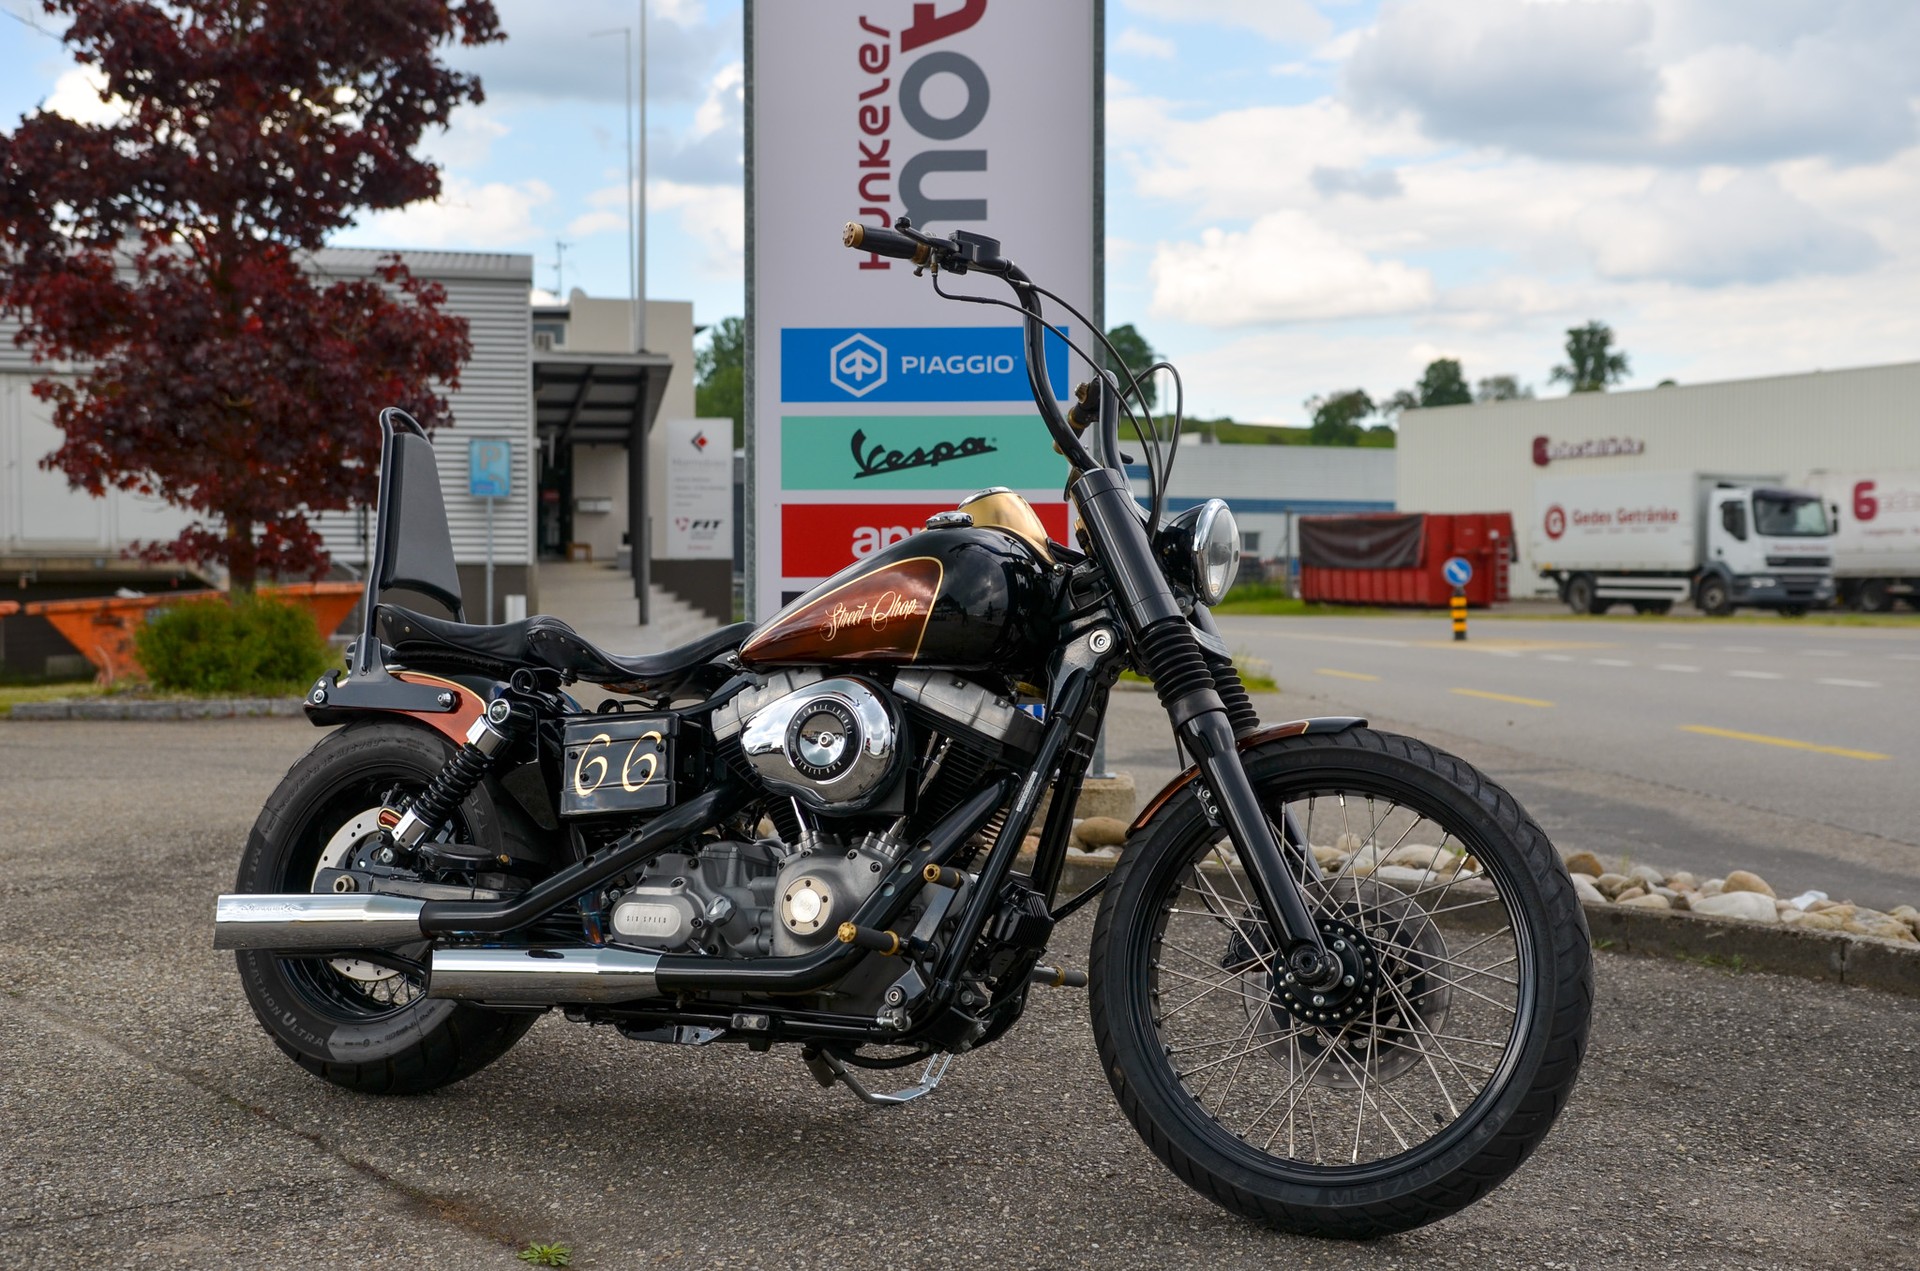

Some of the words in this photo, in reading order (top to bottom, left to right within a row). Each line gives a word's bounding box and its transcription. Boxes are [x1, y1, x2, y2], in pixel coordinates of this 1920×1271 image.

[901, 354, 1015, 375] PIAGGIO
[850, 427, 998, 479] Vespa
[692, 519, 723, 530] FIT
[820, 602, 868, 642] Street
[643, 915, 667, 924] SPEED
[247, 951, 282, 1016] ARATHON
[281, 1011, 326, 1047] ULTRA
